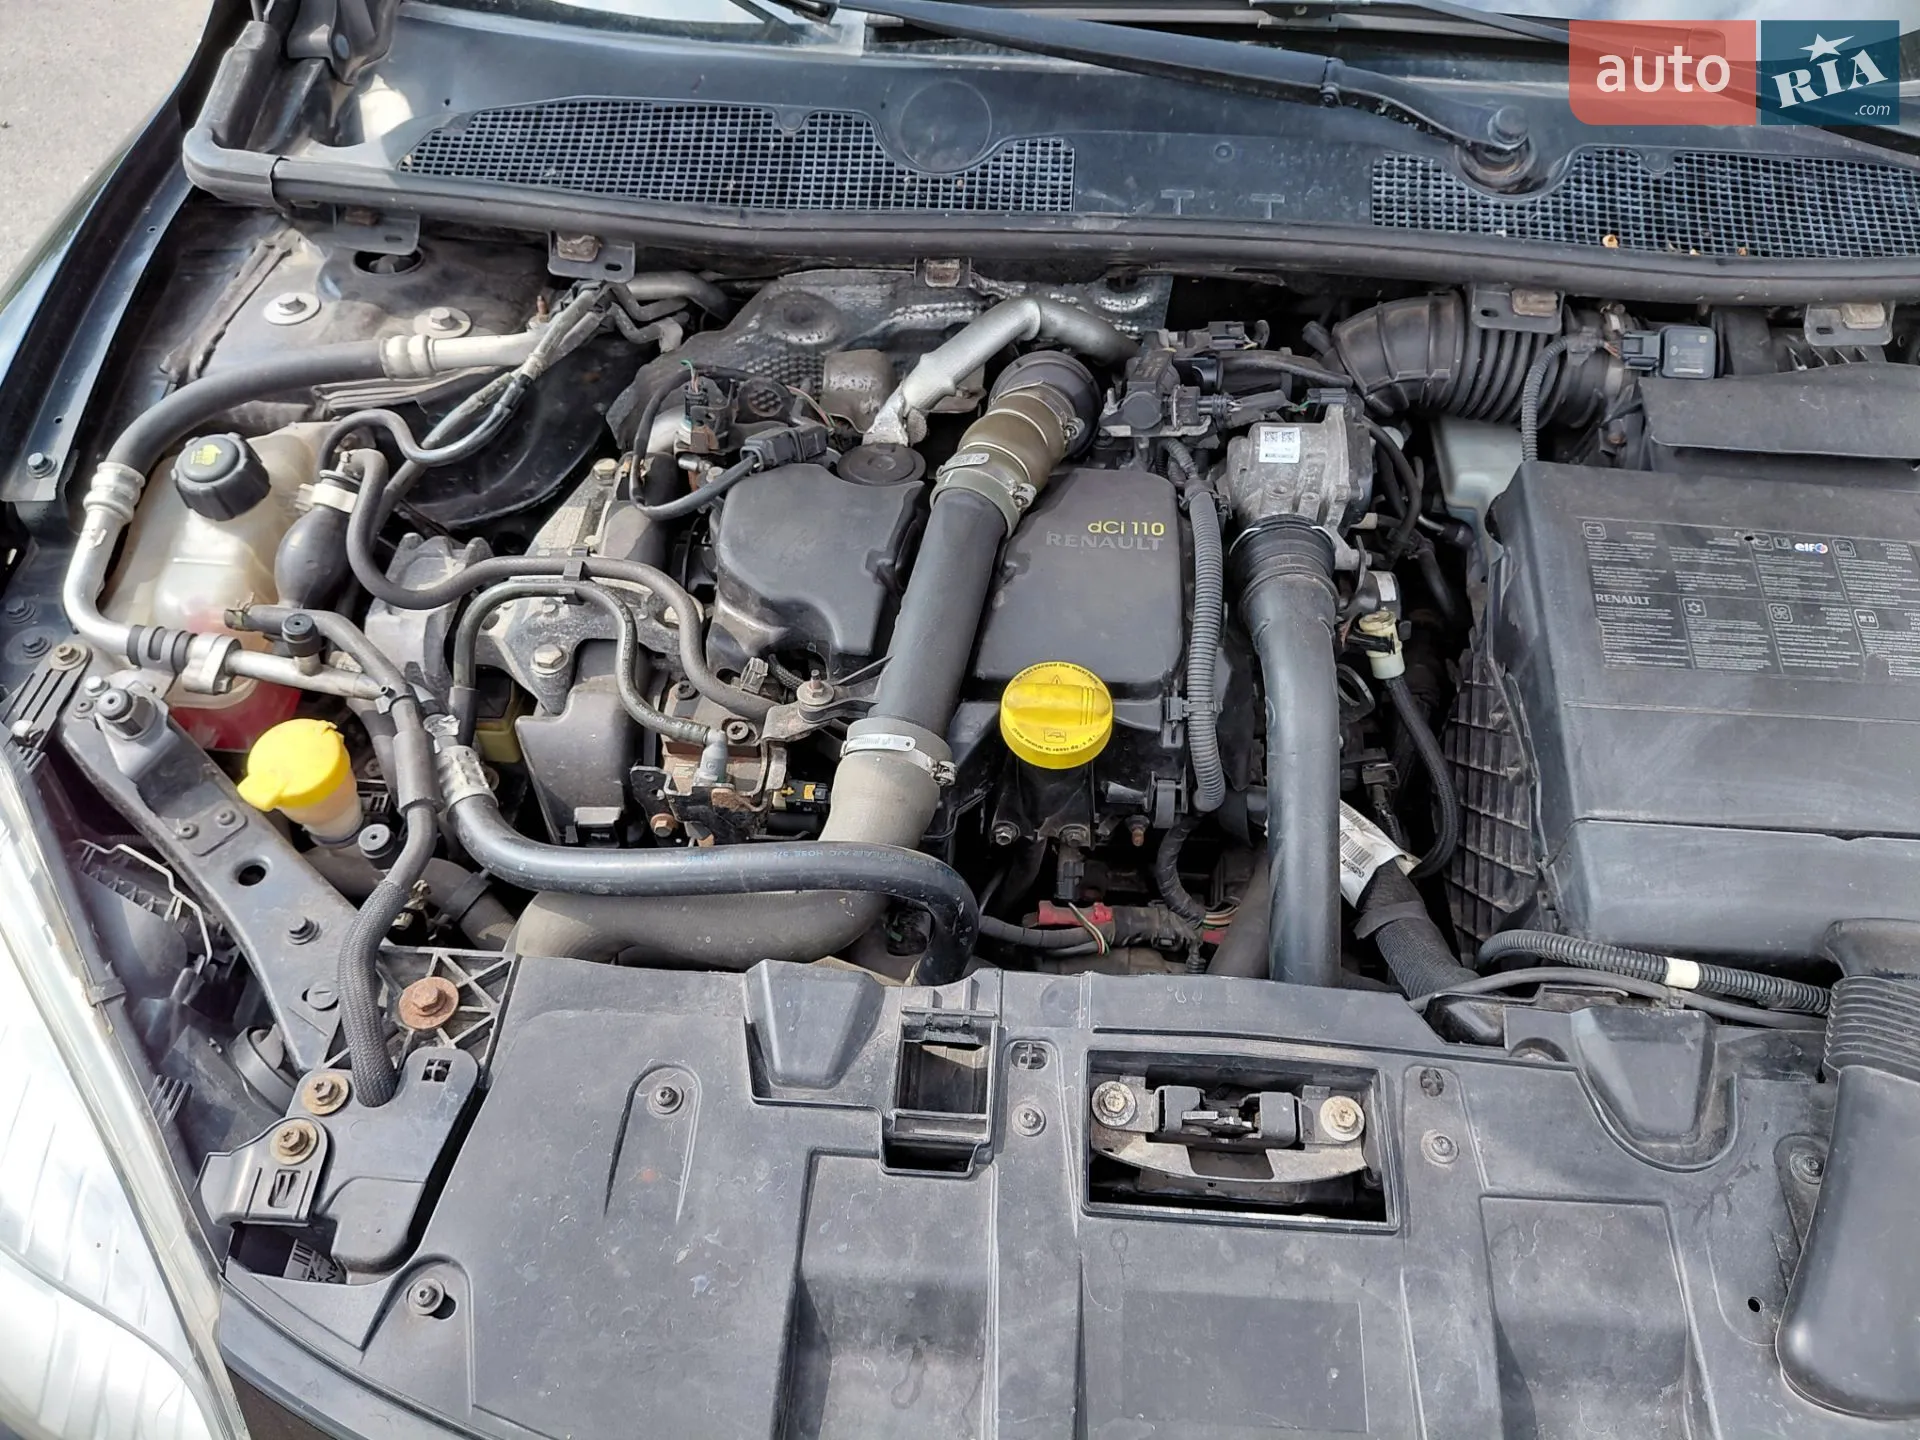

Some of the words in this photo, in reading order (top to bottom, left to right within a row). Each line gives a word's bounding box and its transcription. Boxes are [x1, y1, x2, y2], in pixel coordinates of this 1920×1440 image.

[1087, 520, 1125, 535] dCi
[1131, 521, 1165, 536] 110
[1045, 531, 1164, 551] RENAULT
[1594, 593, 1650, 606] RENAULT
